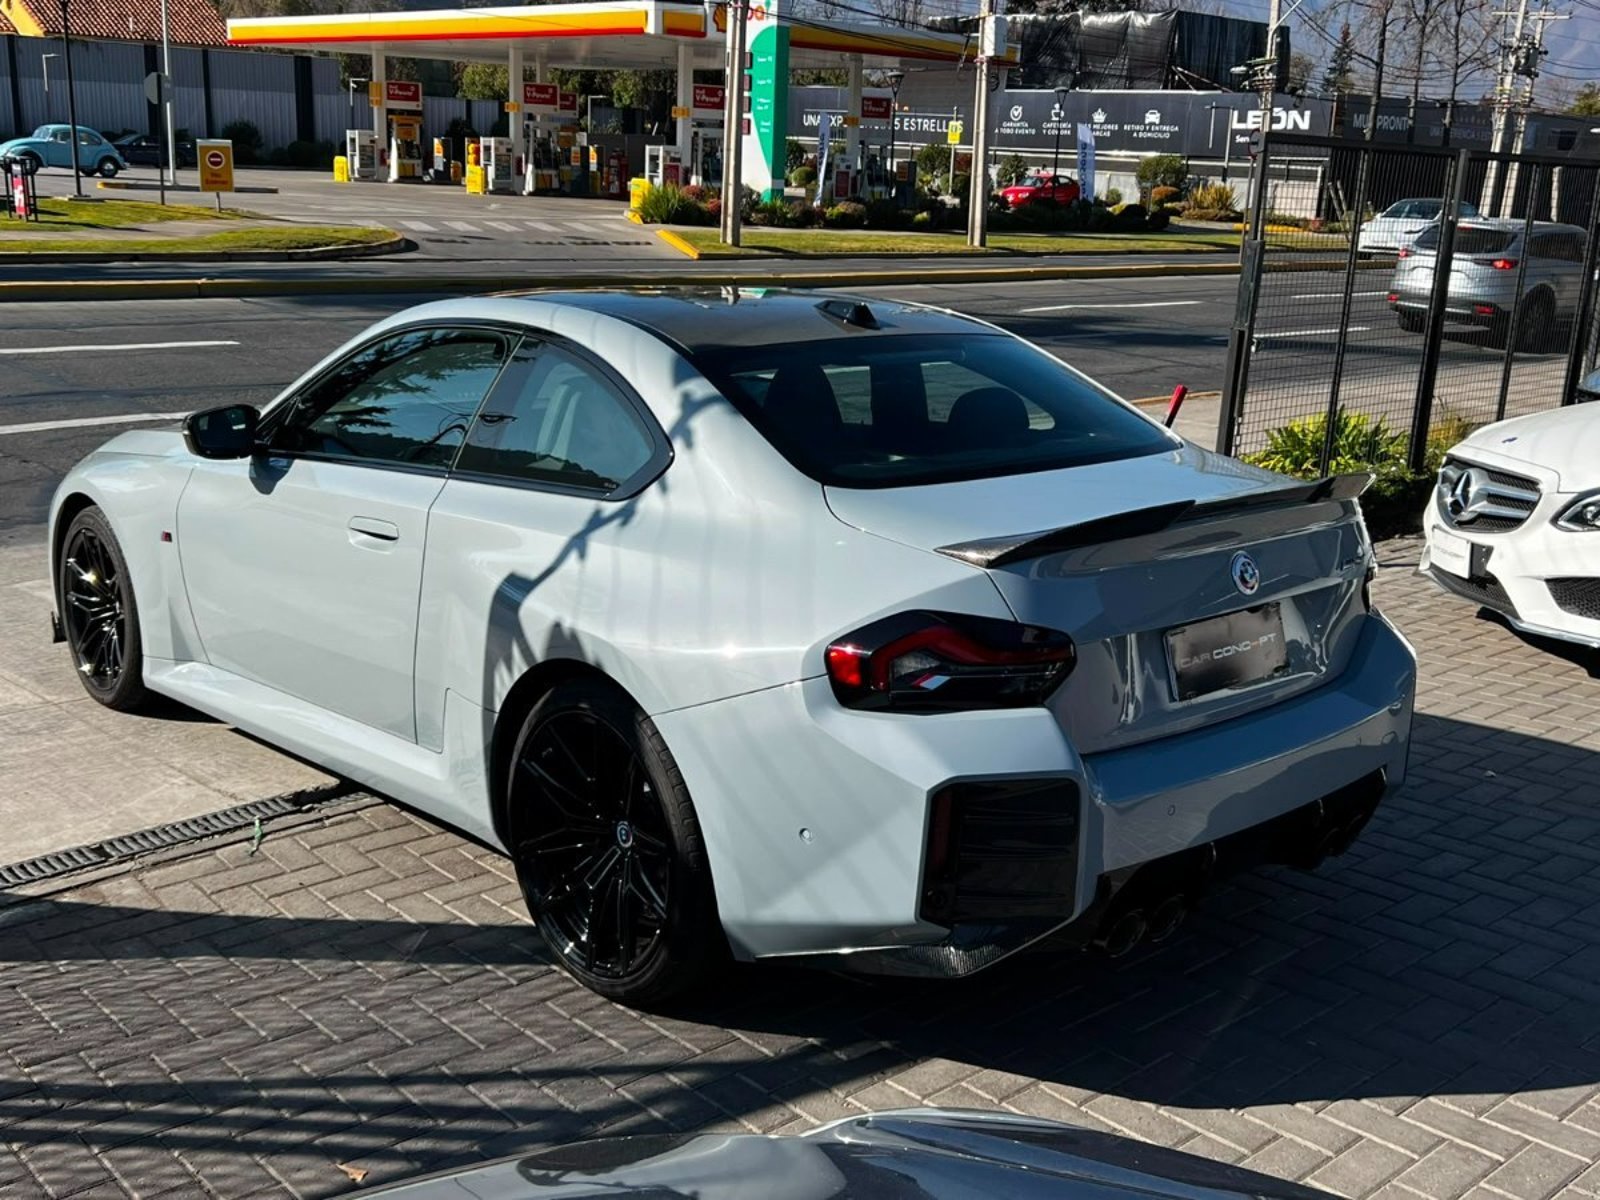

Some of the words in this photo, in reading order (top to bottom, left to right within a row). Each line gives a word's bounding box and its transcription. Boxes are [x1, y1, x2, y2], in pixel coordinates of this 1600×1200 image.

[894, 117, 901, 130] 5
[903, 117, 964, 133] ESTRELLS
[1232, 107, 1311, 131] LEÓN
[1376, 115, 1411, 131] PRONT
[1138, 131, 1171, 139] DOMICILIO
[1151, 124, 1180, 132] ENTREGA
[1180, 652, 1212, 668] CAR
